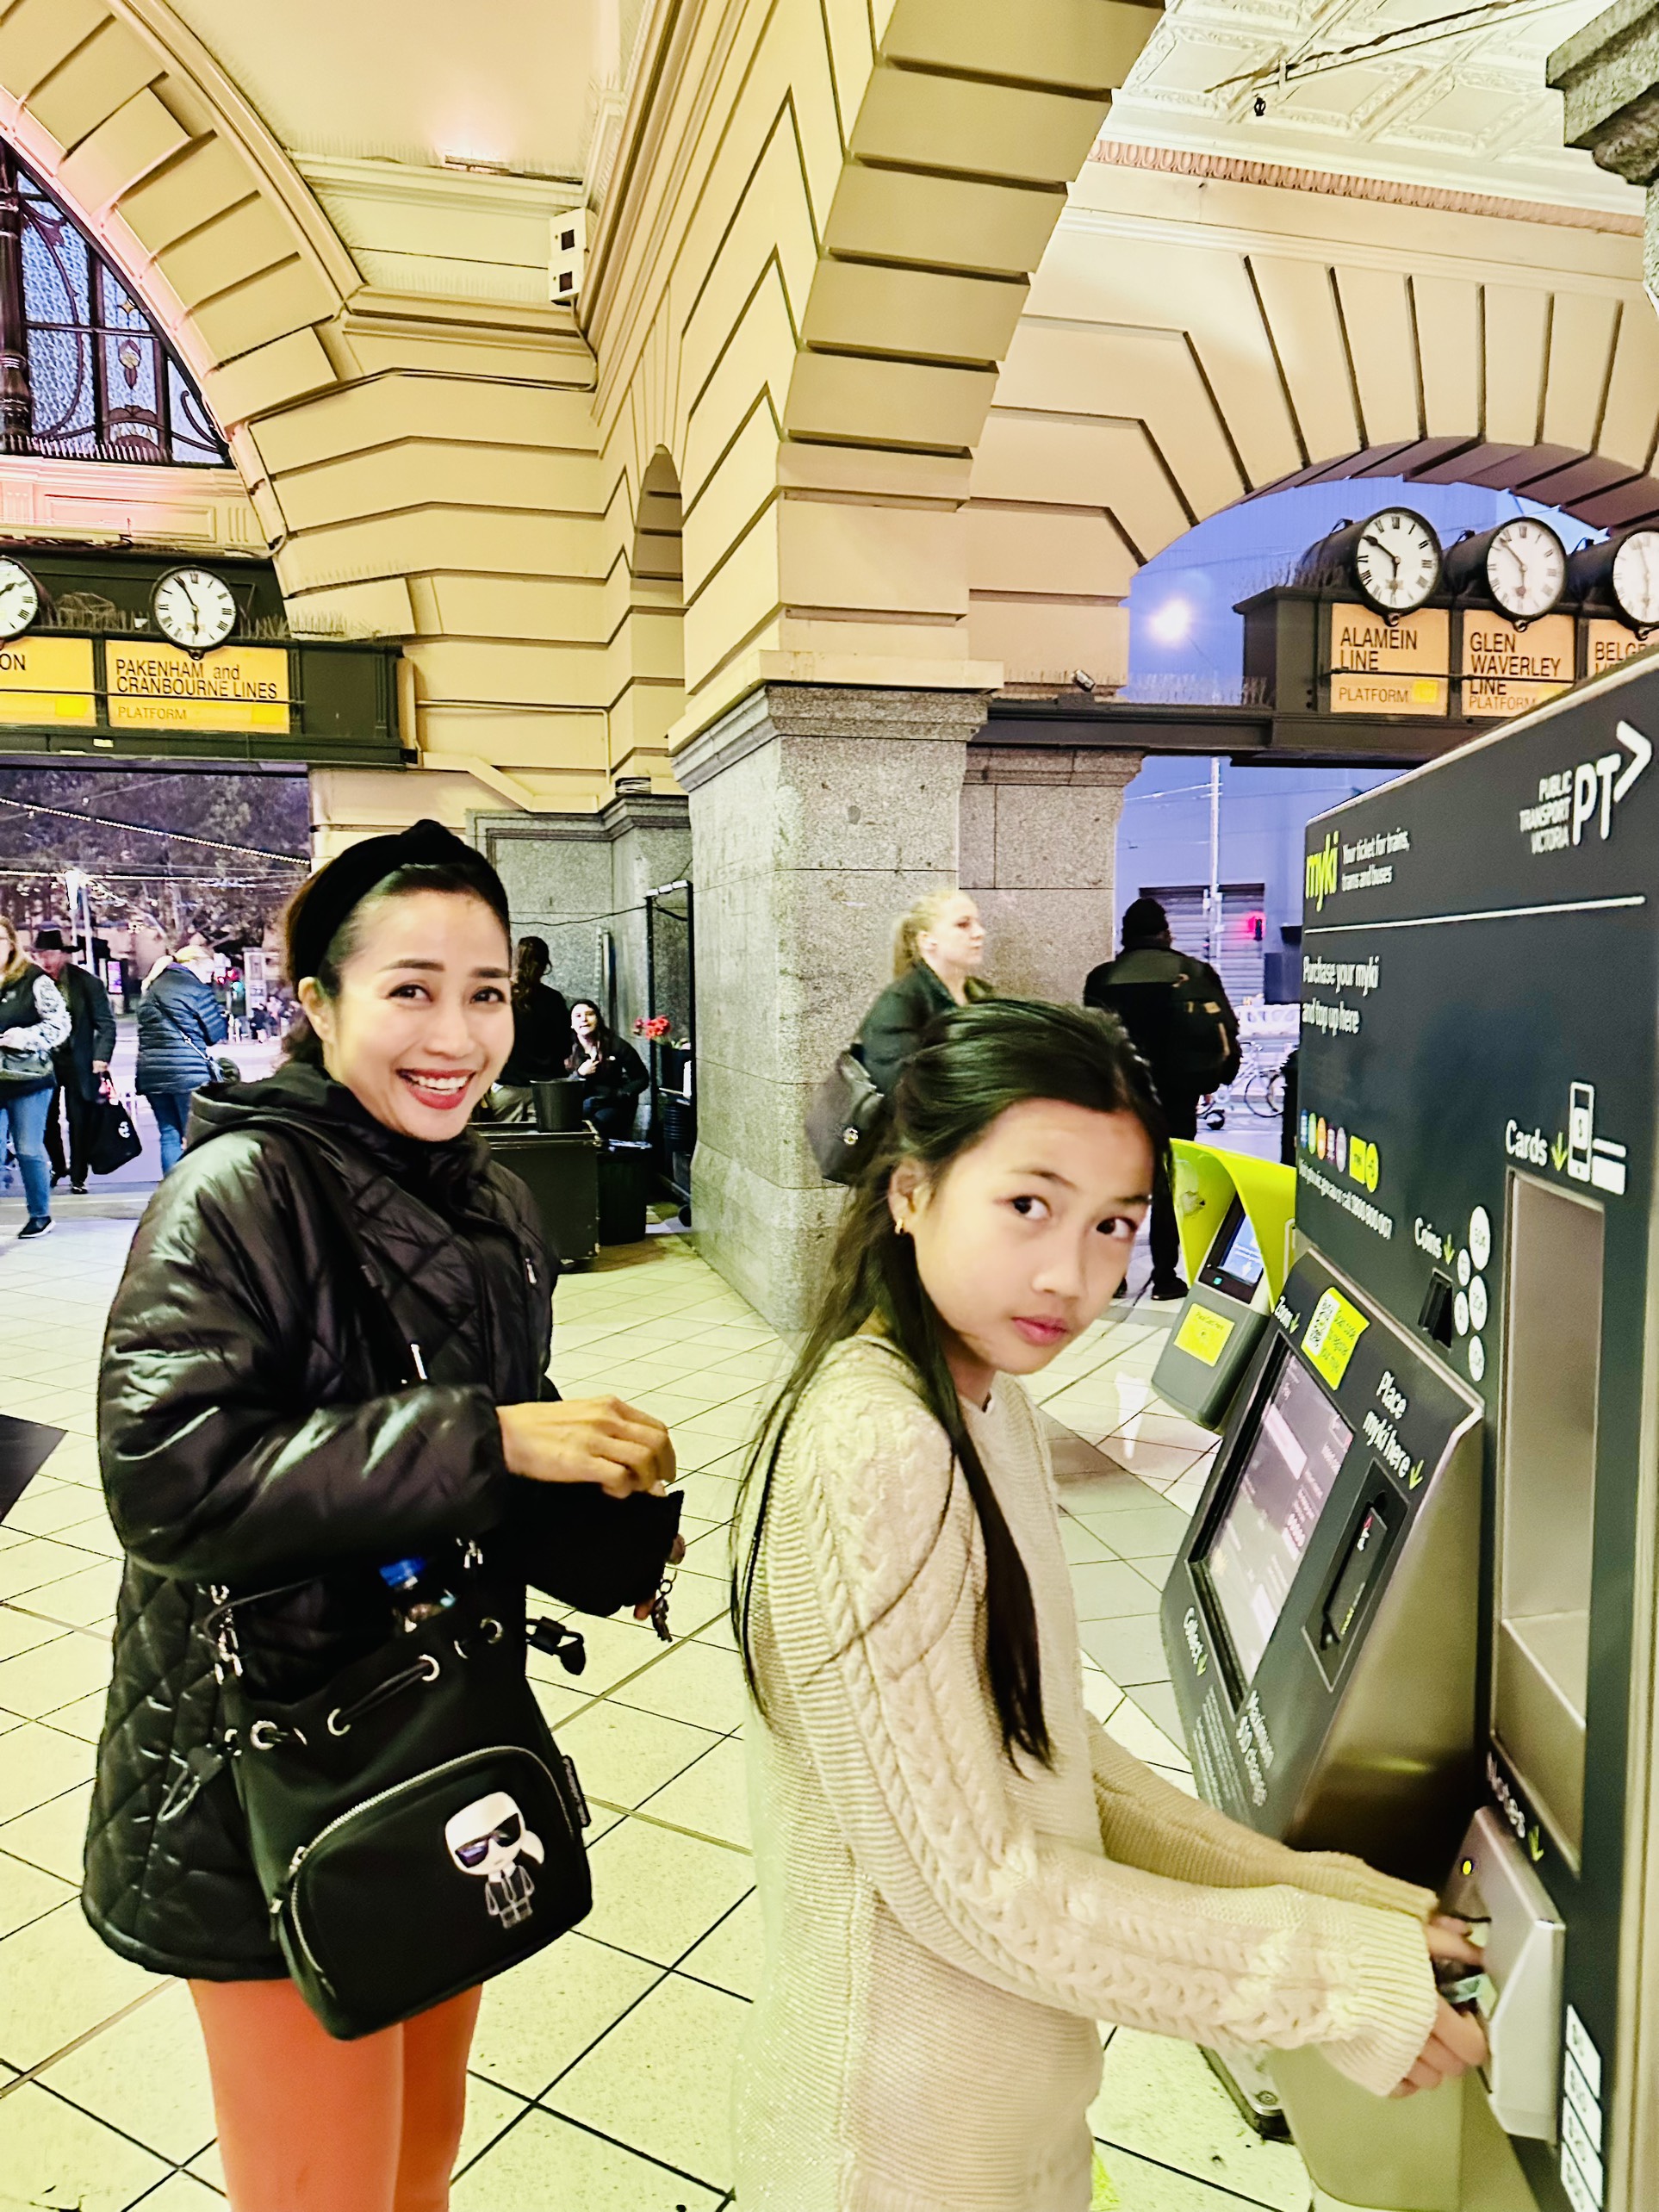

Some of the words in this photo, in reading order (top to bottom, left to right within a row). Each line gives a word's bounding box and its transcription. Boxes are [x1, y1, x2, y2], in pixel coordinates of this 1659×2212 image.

[1340, 627, 1418, 649] ALAMEIN
[1469, 631, 1516, 653] GLEN
[116, 659, 204, 679] PAKENHAM
[213, 664, 240, 680] and
[1339, 649, 1379, 670] LINE
[1471, 654, 1562, 677] WAVERLEY
[116, 676, 228, 698] CRANBOURNE
[233, 682, 278, 699] LINES
[1339, 687, 1409, 704] PLATFORM
[1469, 678, 1507, 696] LINE
[117, 706, 188, 721] PLATFORM
[1305, 830, 1339, 912] myki
[1505, 1119, 1548, 1167] Cards
[1376, 1370, 1407, 1420] Place
[1362, 1410, 1394, 1452] myki
[1382, 1429, 1411, 1479] here
